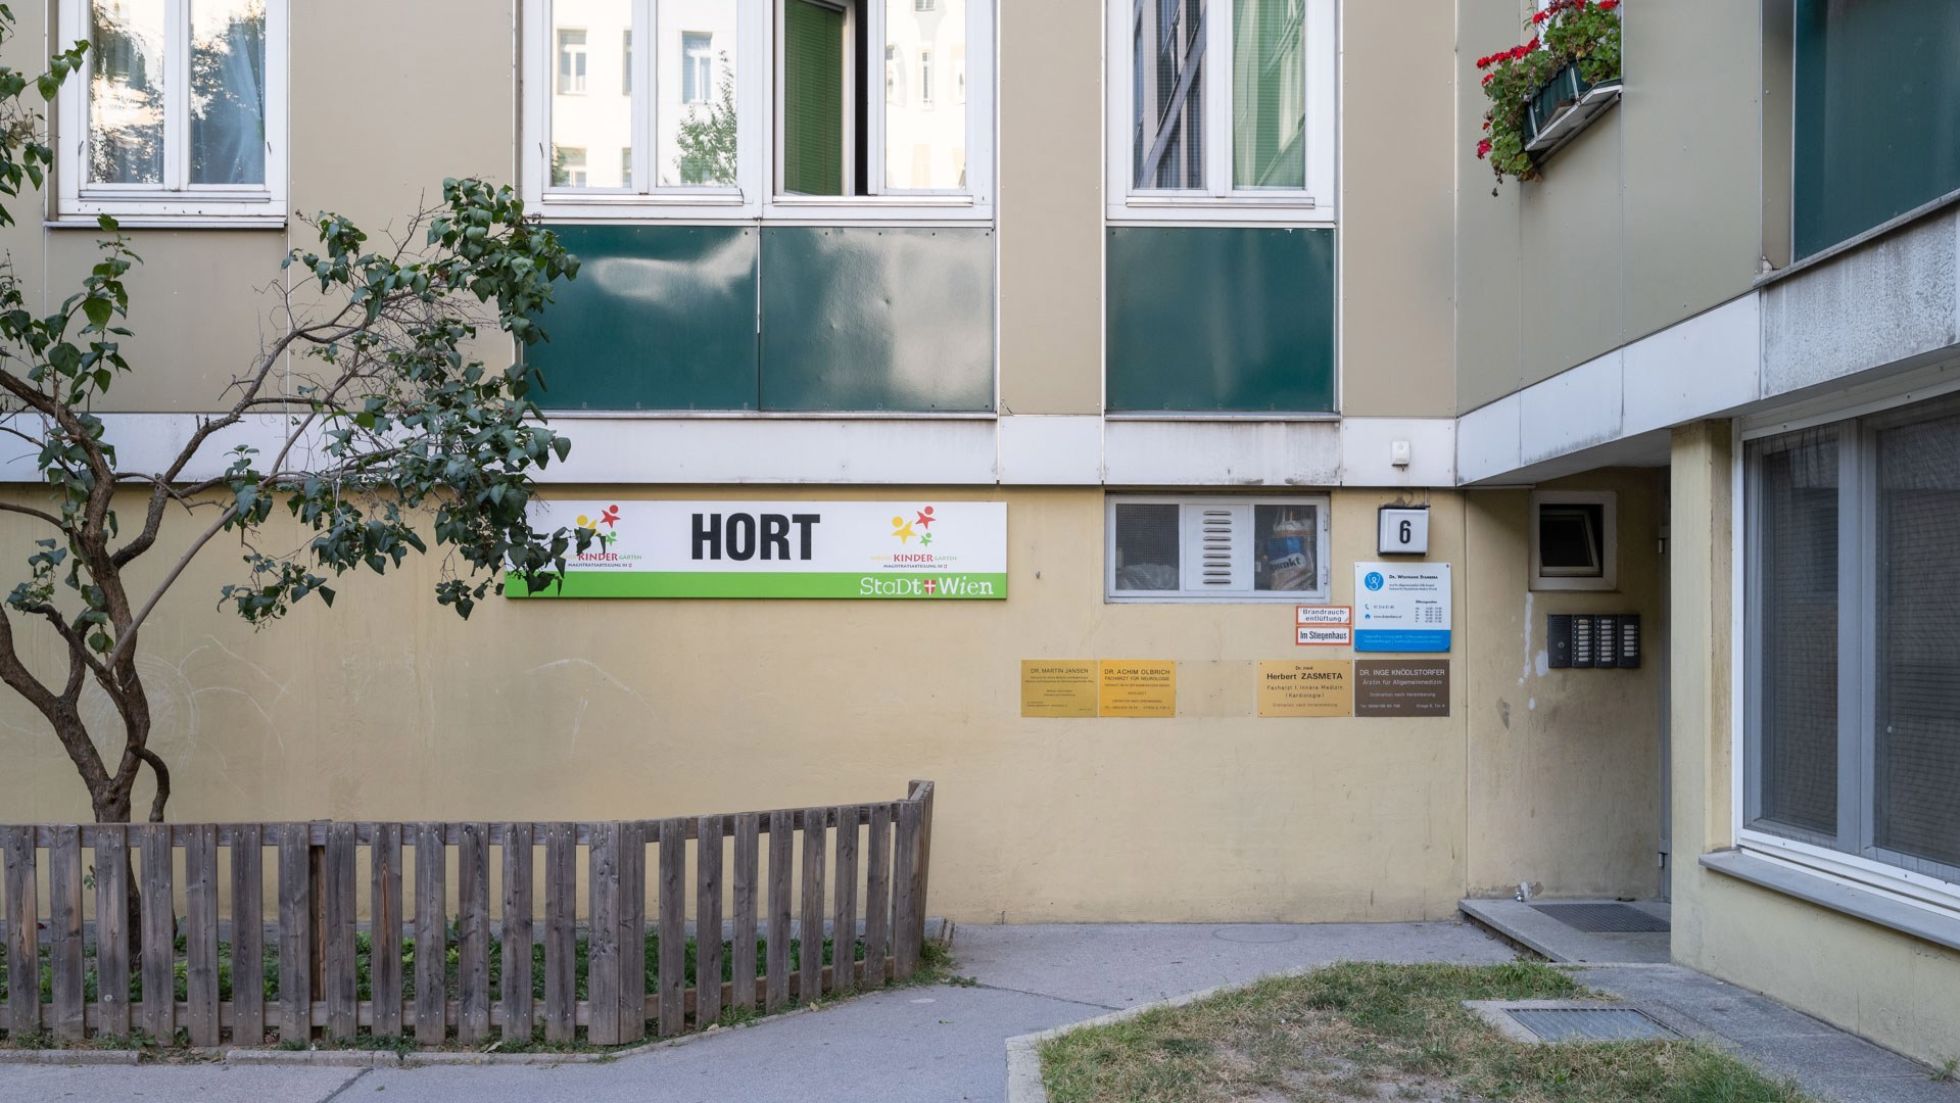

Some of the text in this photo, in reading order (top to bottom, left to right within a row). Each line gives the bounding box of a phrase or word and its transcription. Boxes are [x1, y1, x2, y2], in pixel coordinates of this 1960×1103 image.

[691, 513, 820, 561] HORT
[1399, 520, 1411, 544] 6
[939, 575, 994, 595] Wien
[1309, 631, 1347, 640] Stiegenhaus
[1301, 672, 1343, 680] ZASMETA
[1391, 668, 1445, 676] KNÖDLSTORFER
